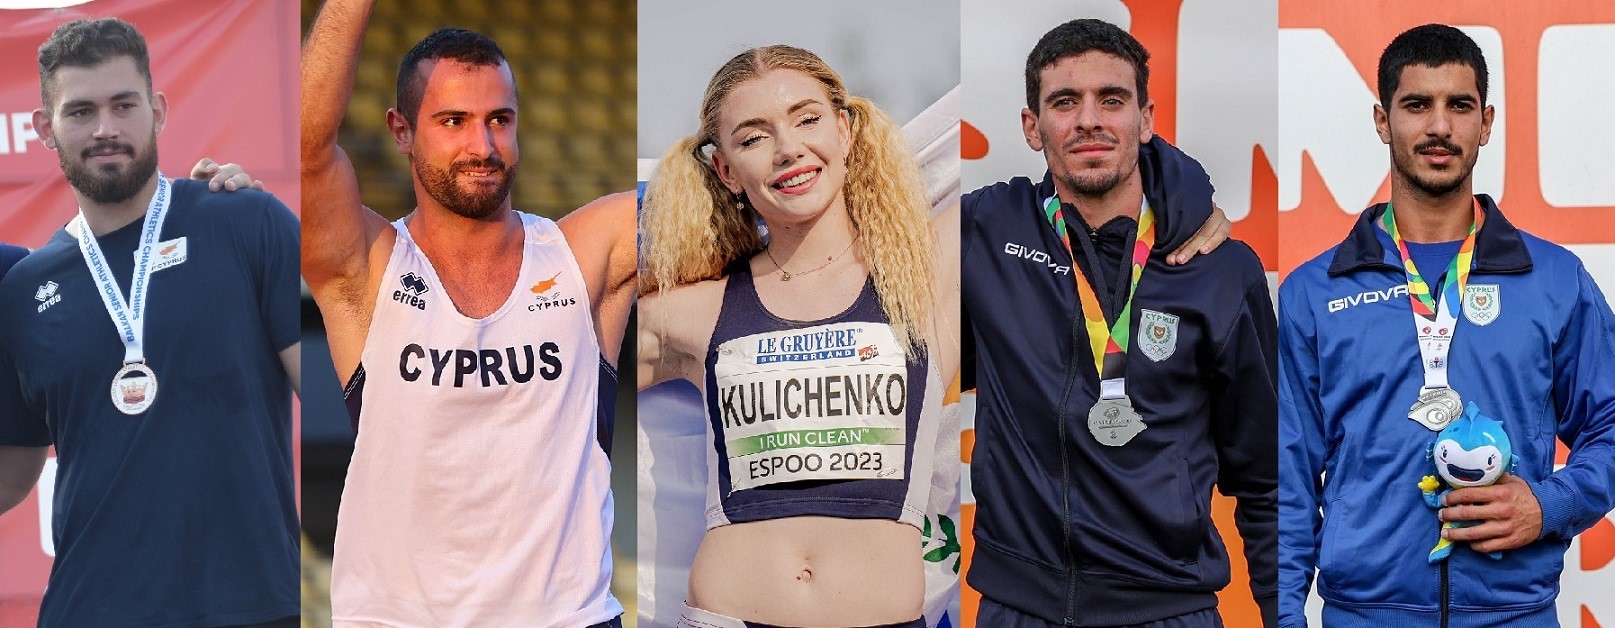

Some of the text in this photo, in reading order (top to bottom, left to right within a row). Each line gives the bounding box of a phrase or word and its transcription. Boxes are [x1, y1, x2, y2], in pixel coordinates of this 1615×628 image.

[145, 201, 163, 243] ATHLETICS
[86, 243, 109, 282] ATHLETICS
[1004, 242, 1071, 276] GIVOVA
[104, 282, 122, 311] SENIOR
[133, 245, 152, 320] CHAMPIONSHIPS
[37, 294, 61, 313] errea
[392, 290, 427, 311] errea
[528, 298, 576, 312] CYPRUS
[1327, 284, 1410, 313] GIVOVA
[117, 309, 135, 342] BALKAN
[1145, 313, 1176, 325] CYPRUS
[756, 339, 777, 354] LE
[780, 328, 857, 353] GRUYÈRE
[399, 341, 563, 388] CYPRUS
[760, 350, 852, 363] SWITZERLAND
[721, 373, 906, 429] KULICHENKO
[759, 437, 764, 449] I
[766, 432, 801, 448] RUN
[749, 452, 883, 480] ESPOO 2023
